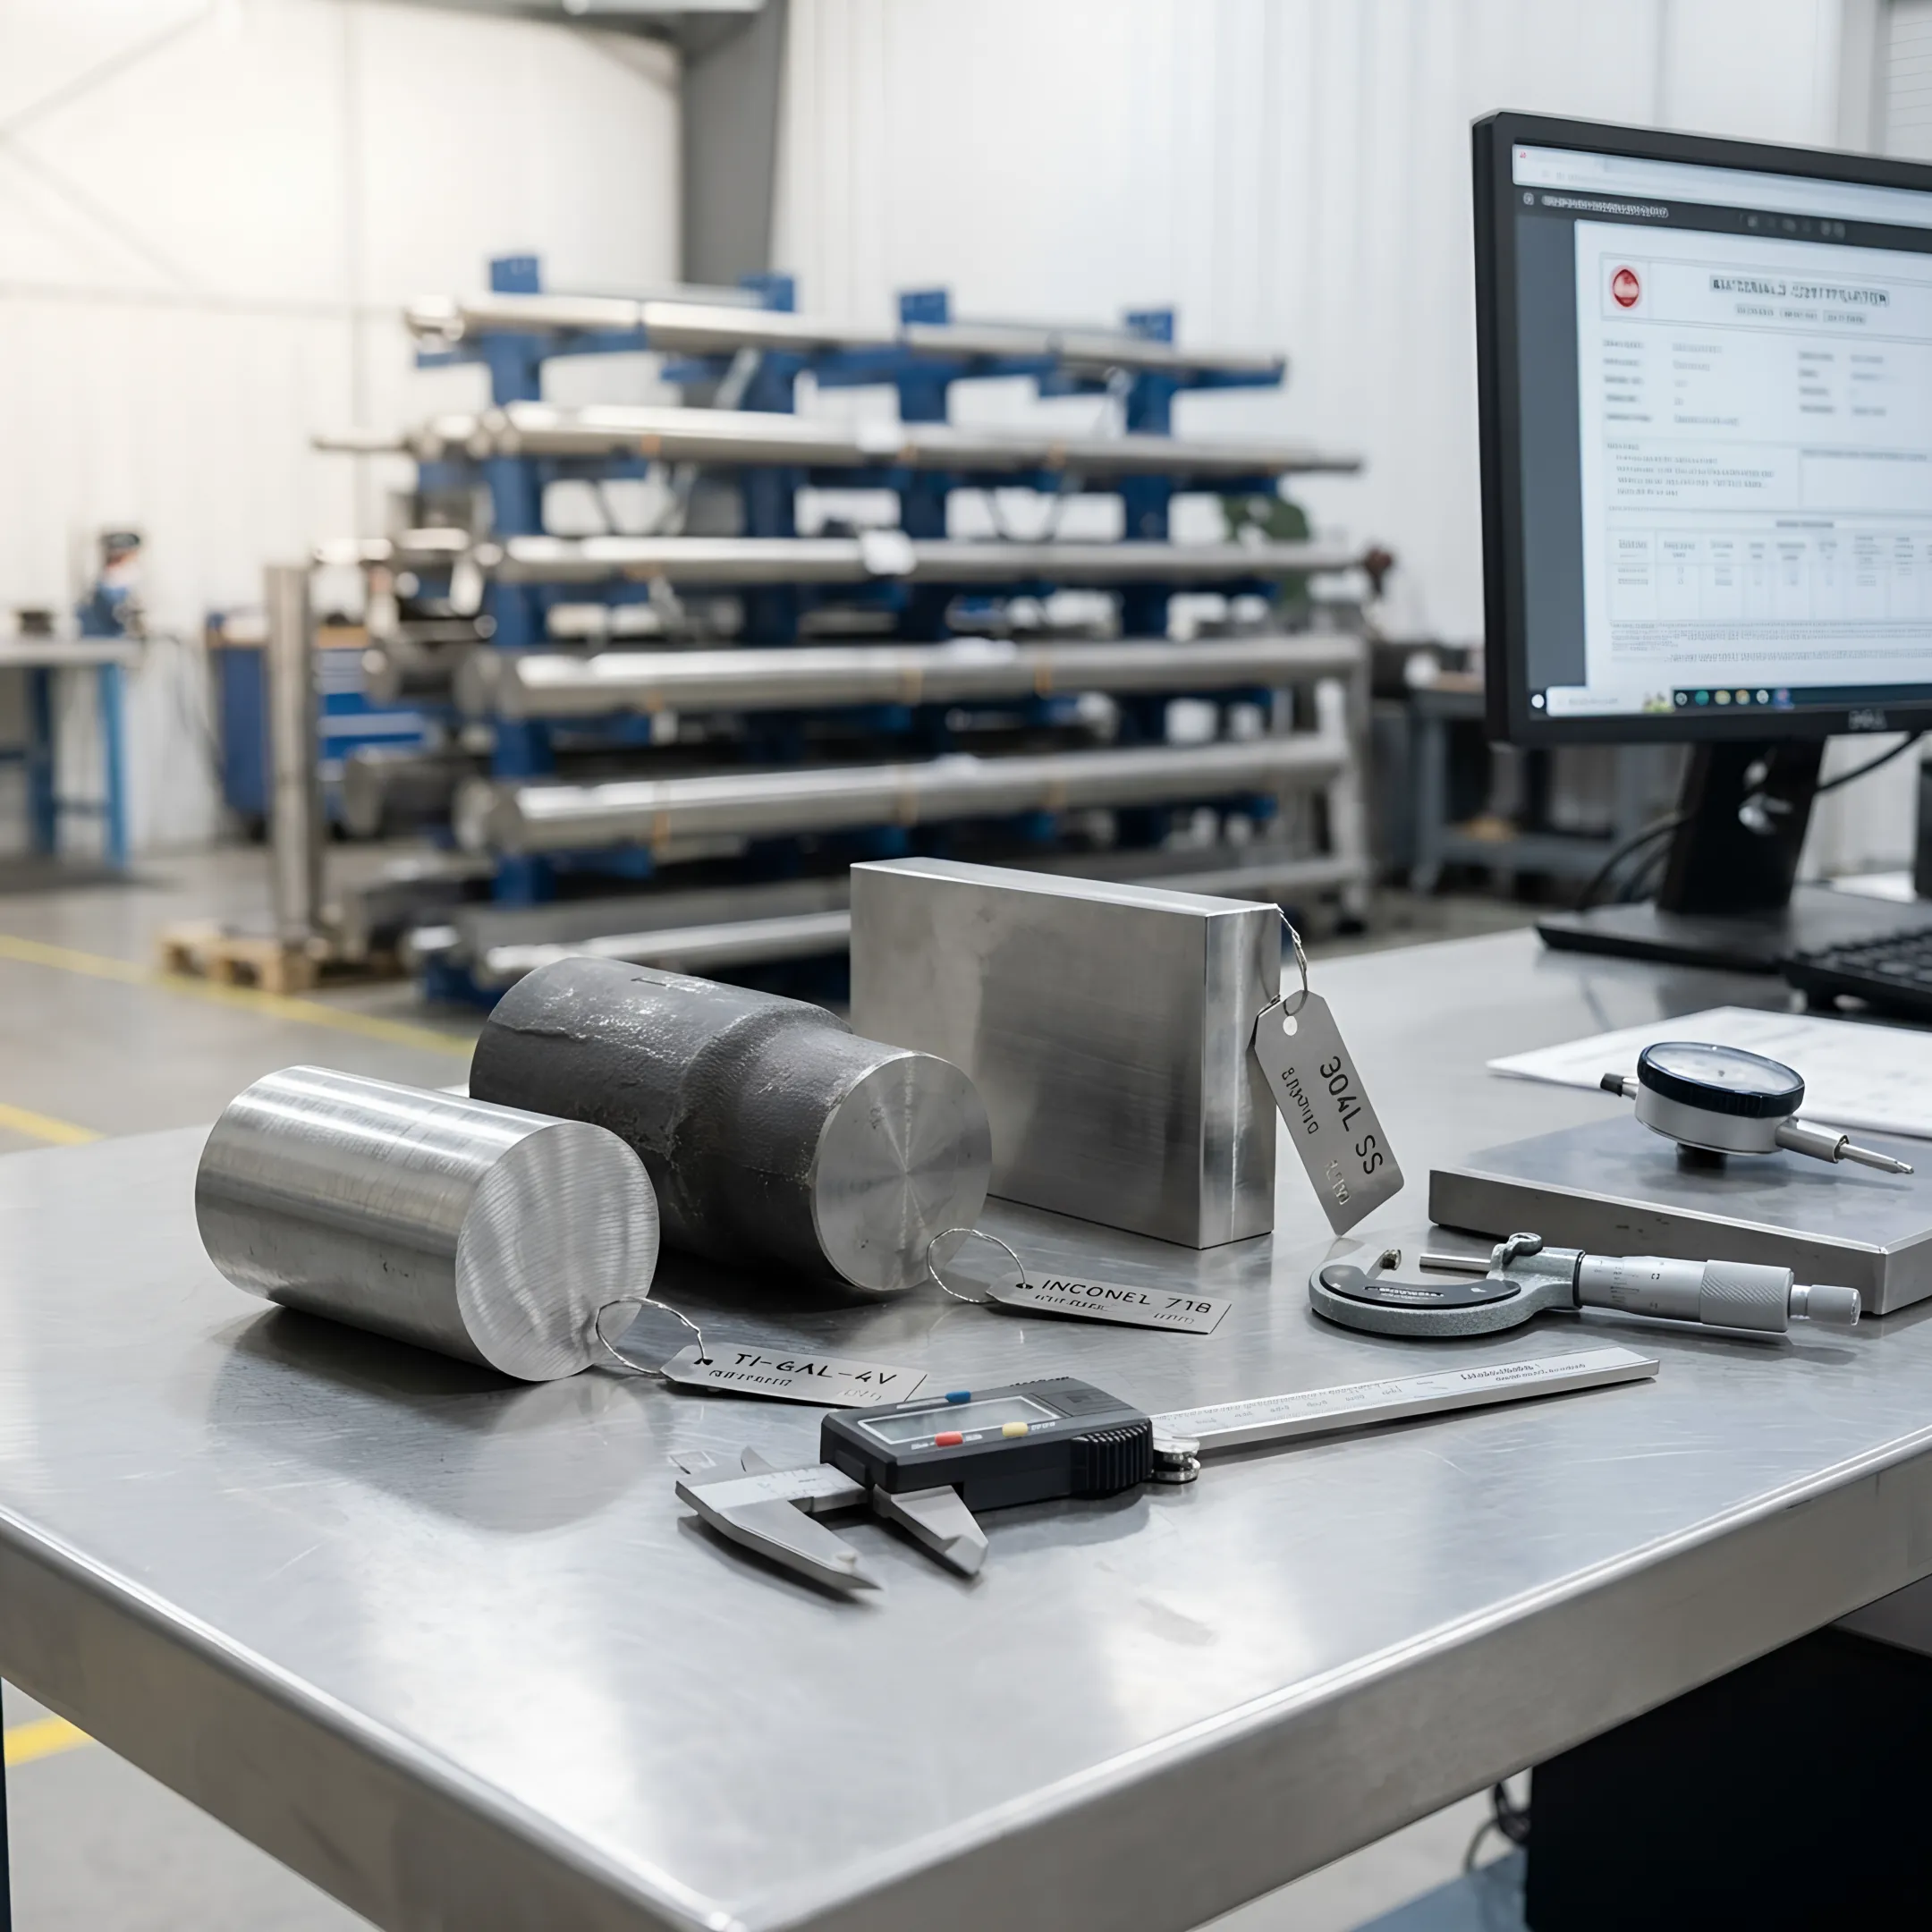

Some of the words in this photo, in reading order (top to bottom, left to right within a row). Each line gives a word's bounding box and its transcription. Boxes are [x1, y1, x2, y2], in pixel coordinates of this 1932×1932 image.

[1319, 1055, 1361, 1131] 304L
[1355, 1134, 1384, 1174] SS
[1041, 1279, 1150, 1305] INCONEL
